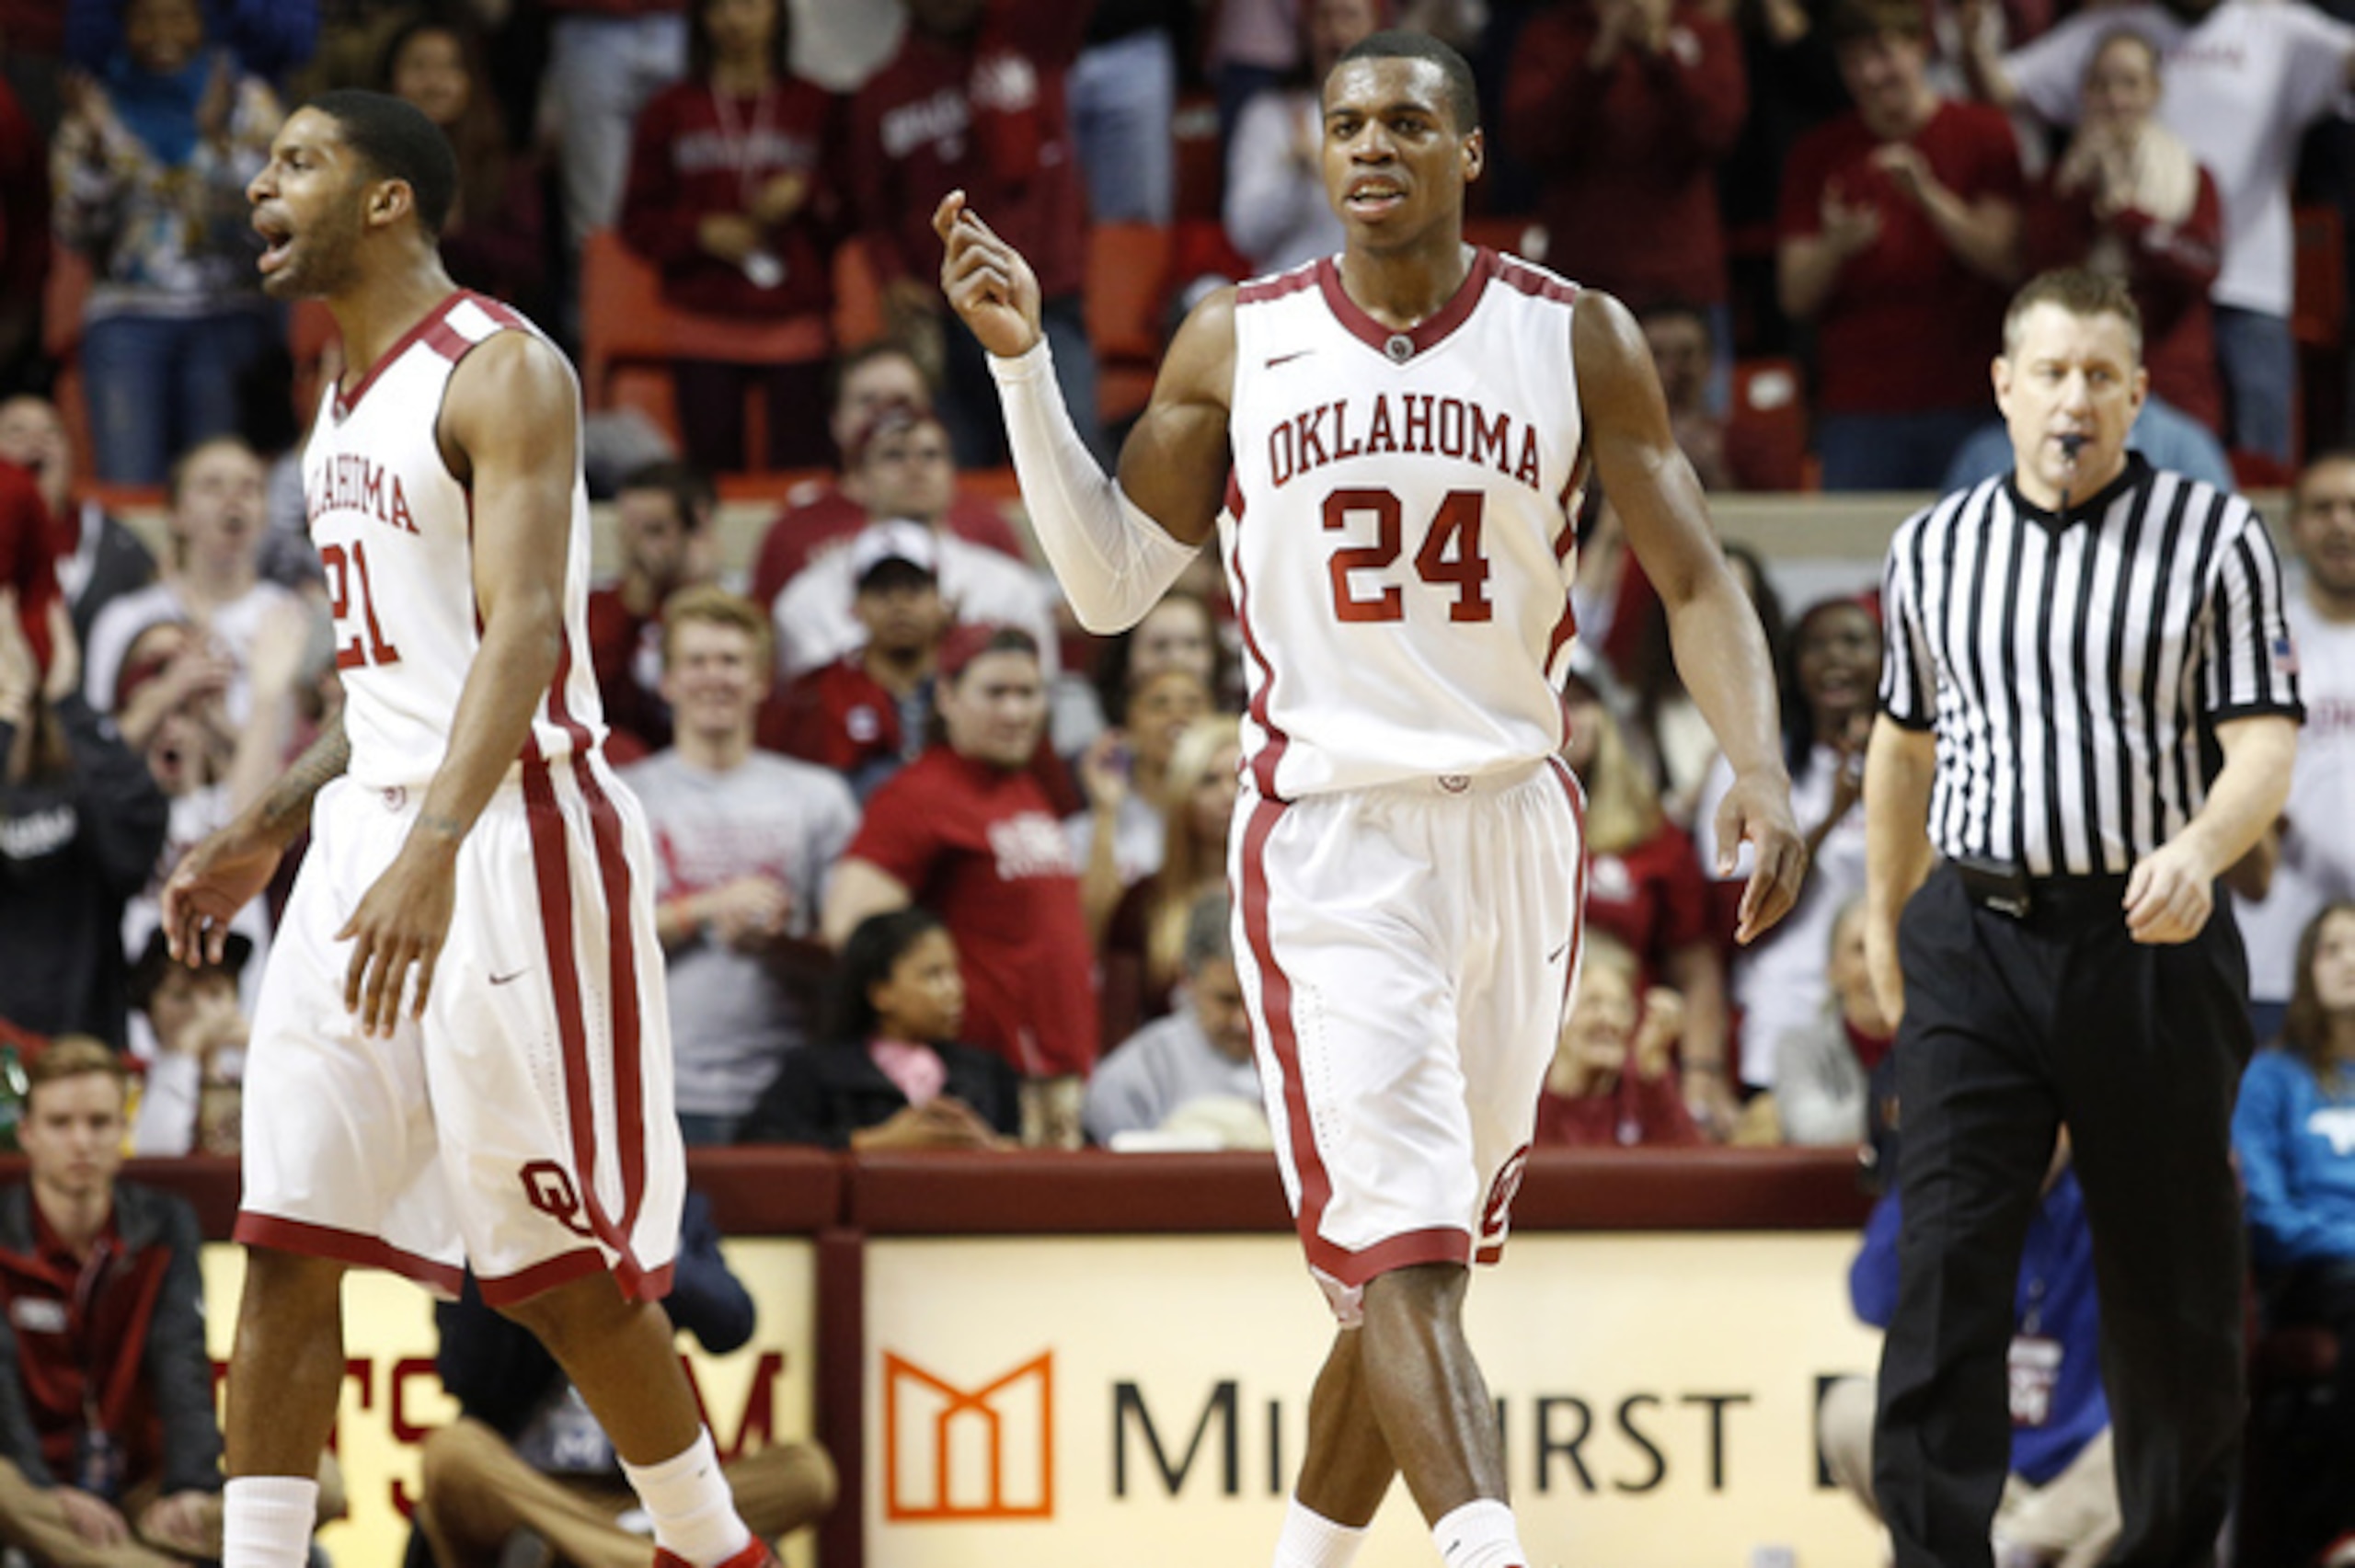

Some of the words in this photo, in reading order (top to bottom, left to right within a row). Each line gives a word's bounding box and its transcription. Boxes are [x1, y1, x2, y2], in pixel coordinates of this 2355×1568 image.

[307, 454, 420, 535] LAHOMA
[1269, 392, 1540, 492] OKLAHOMA
[1320, 487, 1493, 623] 24
[1114, 1380, 1753, 1496] MIRST
